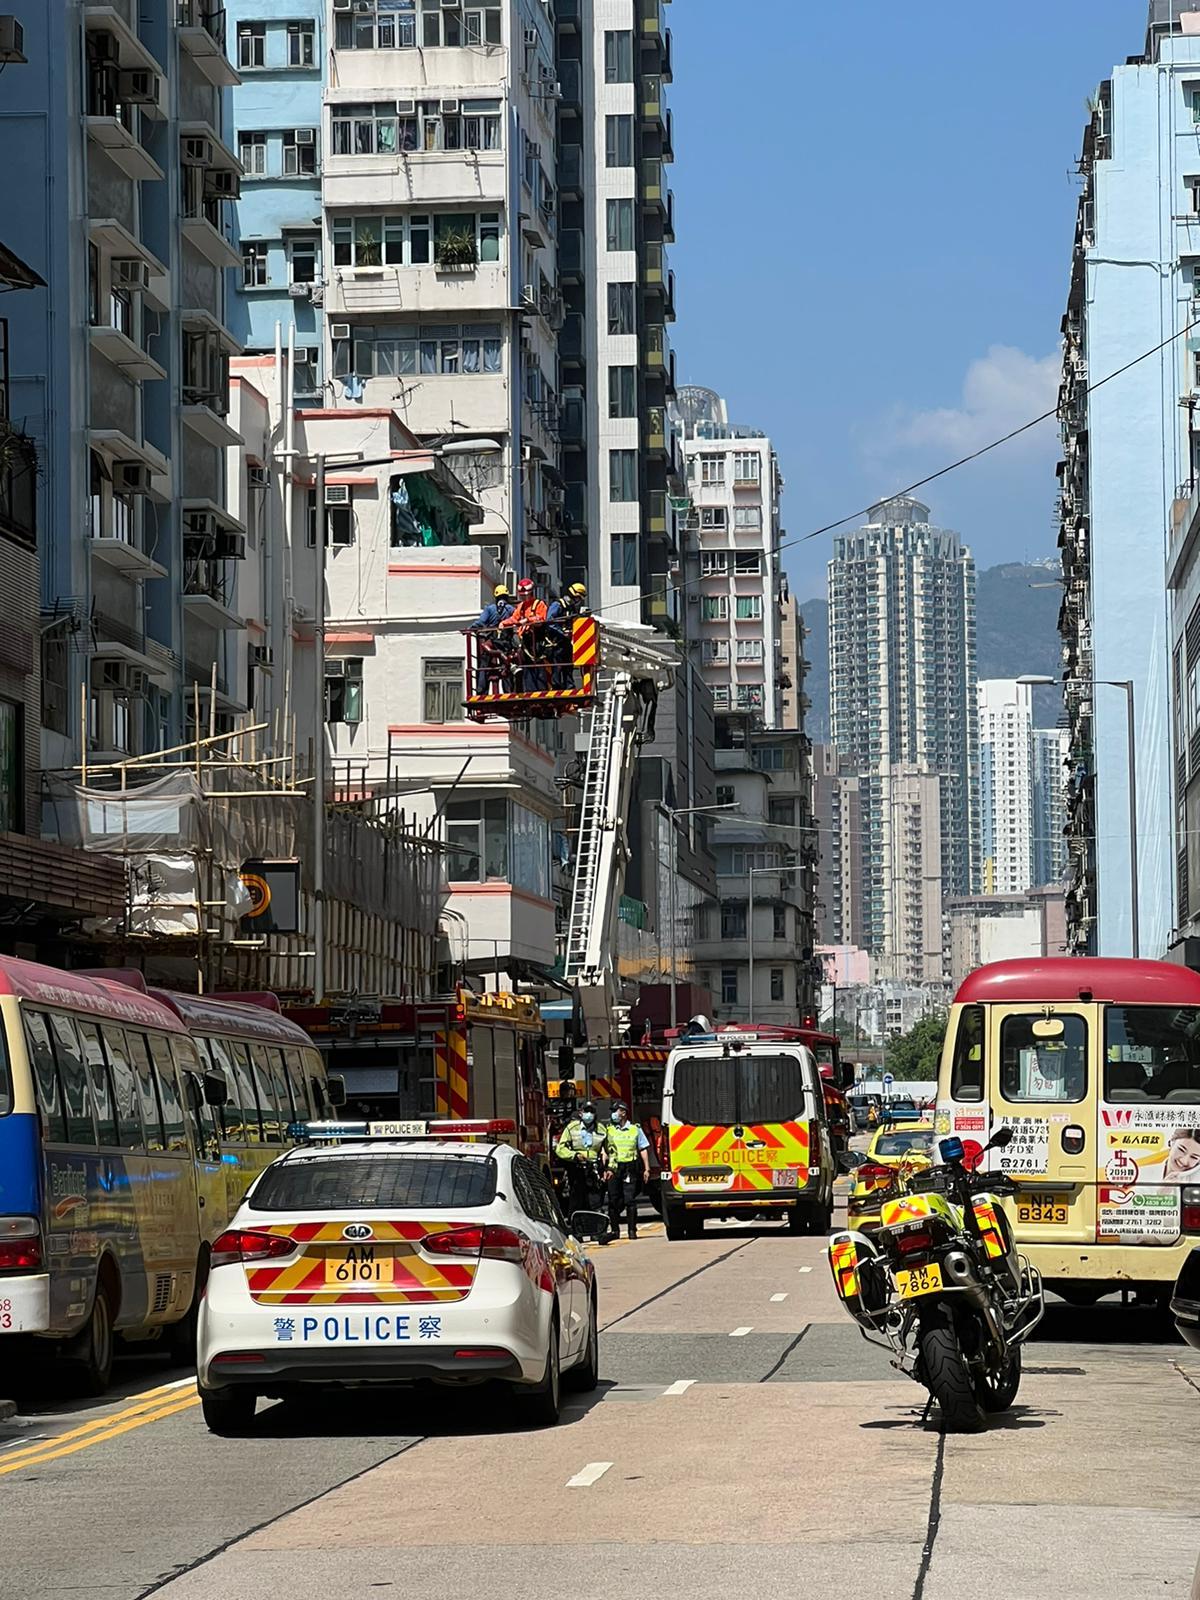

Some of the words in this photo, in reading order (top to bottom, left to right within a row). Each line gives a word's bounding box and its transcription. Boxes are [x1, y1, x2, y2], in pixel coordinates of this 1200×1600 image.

[384, 1124, 411, 1134] POLICE
[711, 1150, 765, 1163] POLICE
[1012, 1158, 1038, 1168] 2761
[1031, 1194, 1055, 1208] NR
[1019, 1207, 1066, 1221] 8343
[348, 1227, 367, 1236] KIA
[345, 1246, 375, 1264] AM
[336, 1263, 381, 1281] 6101
[909, 1267, 929, 1282] AM
[900, 1276, 941, 1295] 7862
[0, 1313, 12, 1328] 3
[273, 1317, 296, 1341] 警
[303, 1316, 411, 1341] POLICE
[418, 1315, 442, 1339] 察
